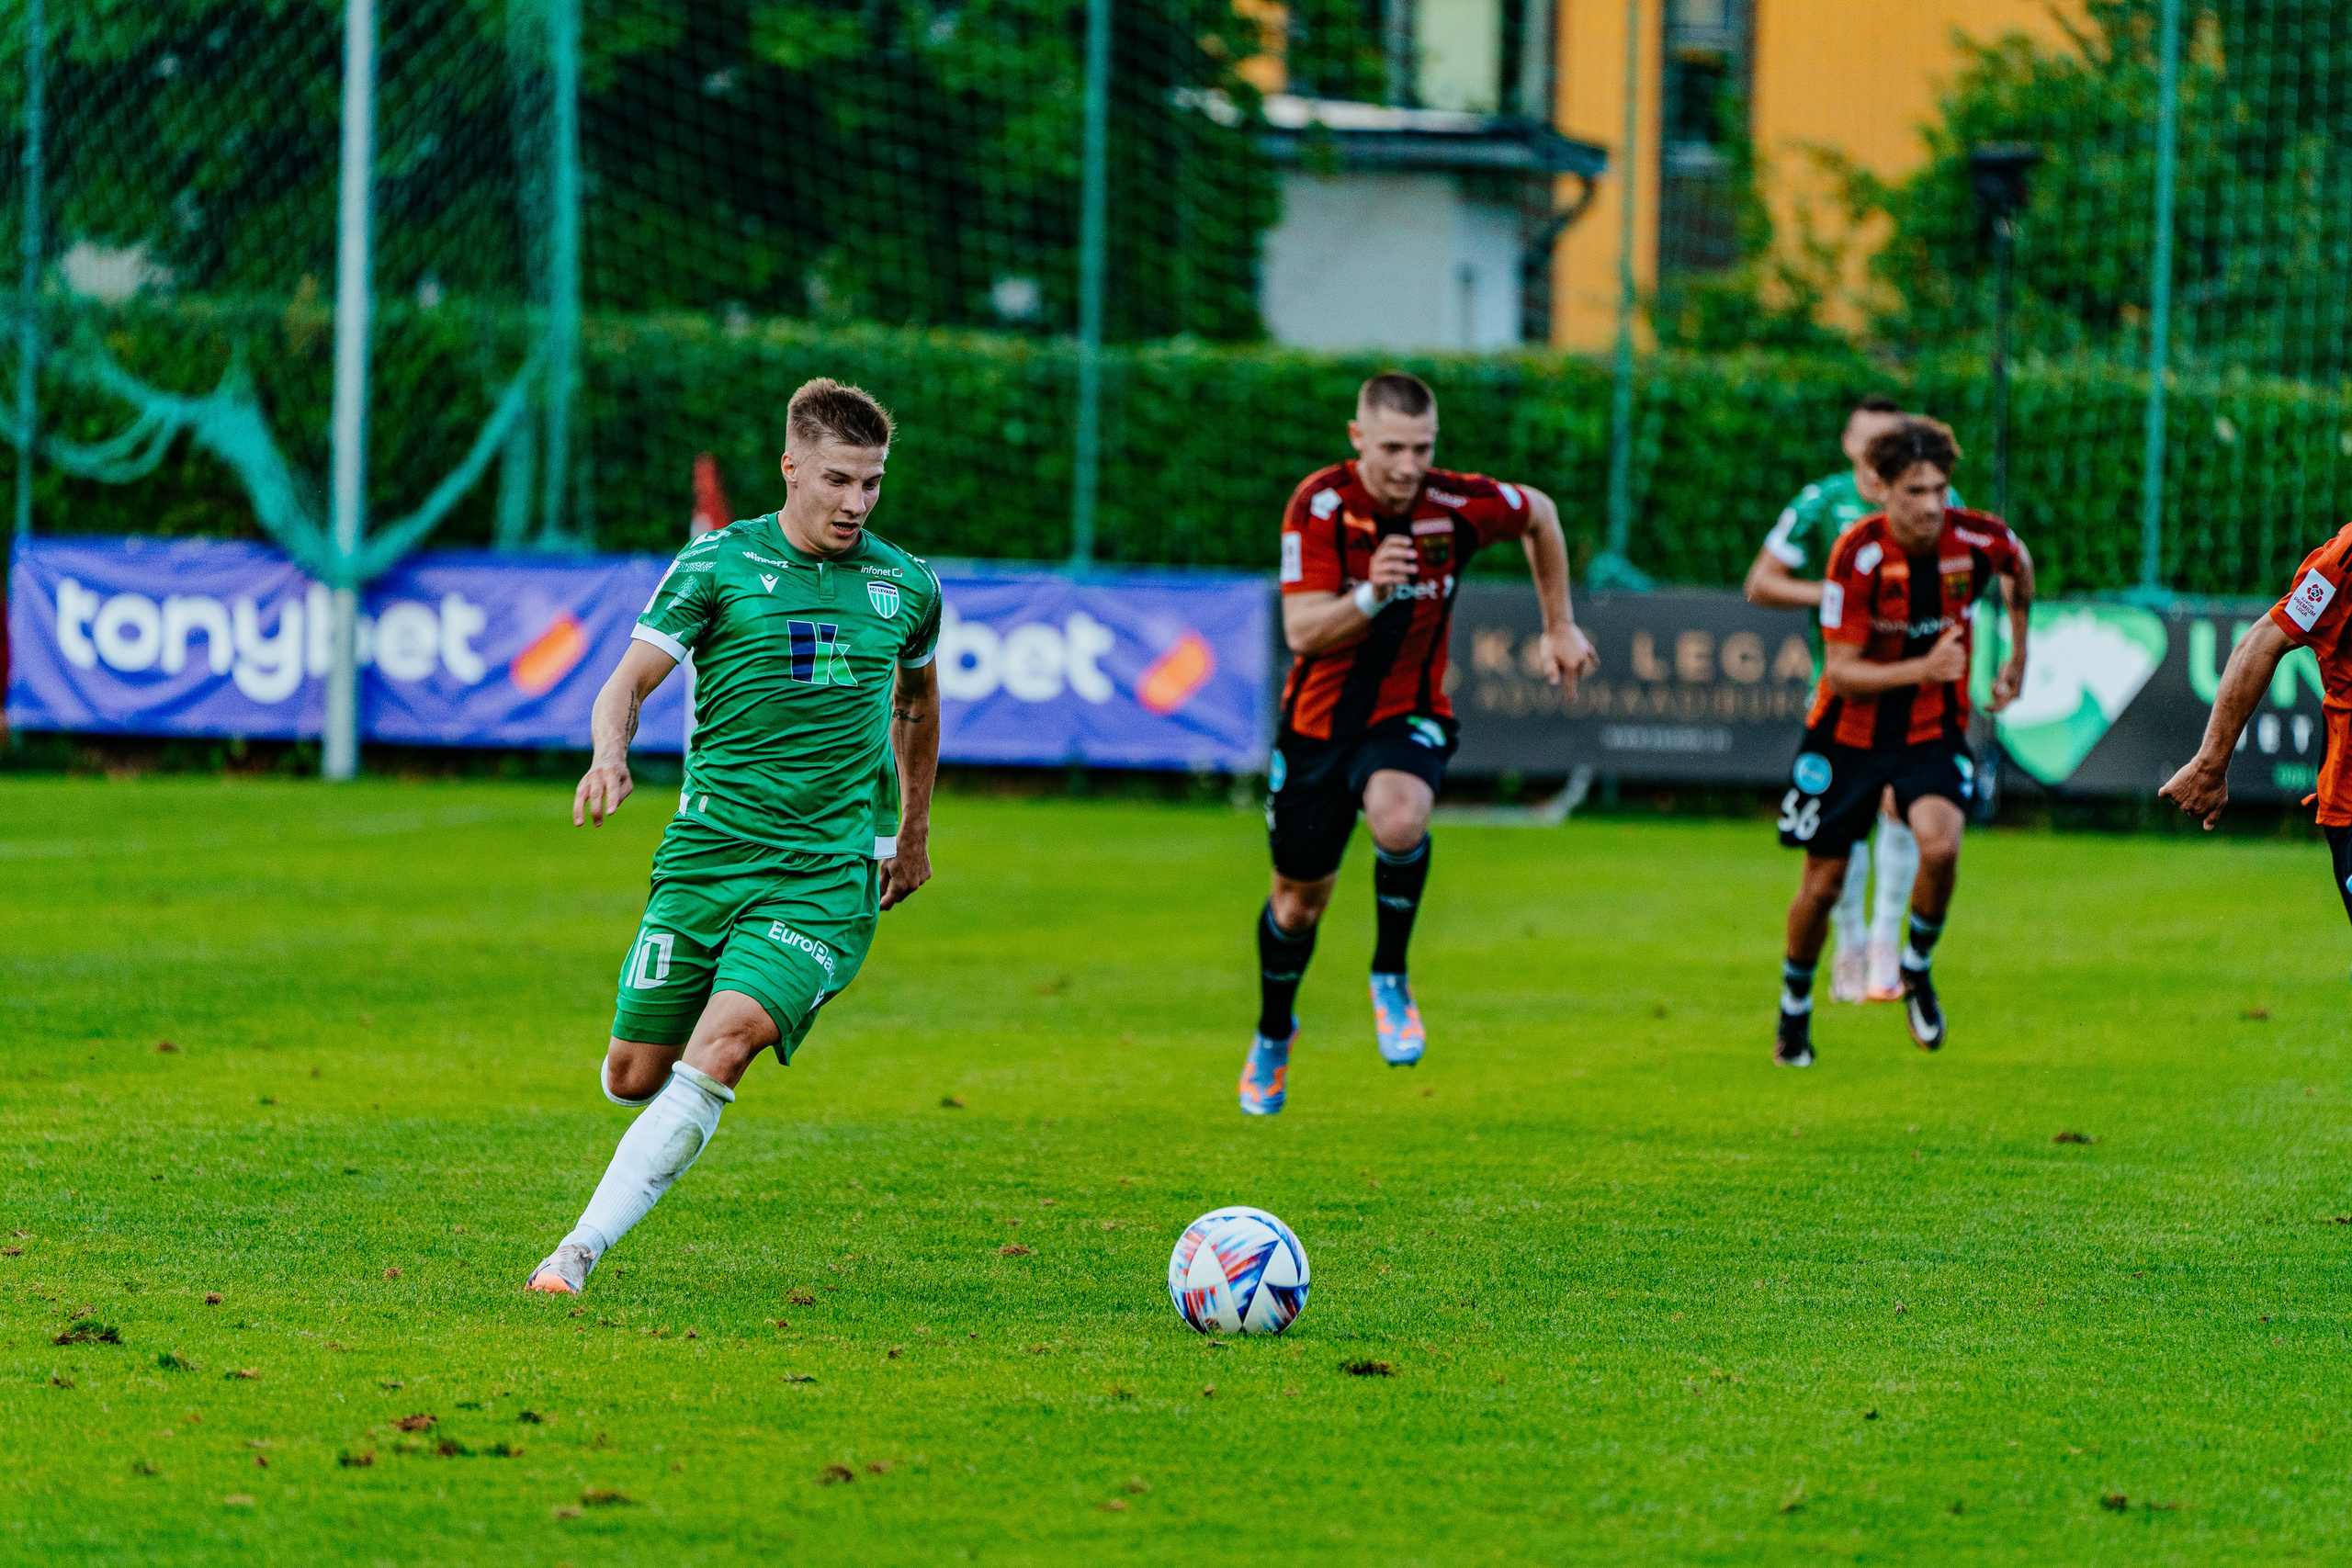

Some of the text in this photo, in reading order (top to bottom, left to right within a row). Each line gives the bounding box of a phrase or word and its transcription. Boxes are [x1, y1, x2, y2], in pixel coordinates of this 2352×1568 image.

[861, 565, 891, 576] infonet
[877, 588, 898, 596] LEVADIA
[2294, 596, 2316, 616] PREMIUM
[2296, 605, 2307, 616] LIIGA
[56, 578, 489, 704] tonybet
[1777, 788, 1821, 840] 56
[626, 927, 674, 989] 10
[768, 920, 834, 985] EuroPa
